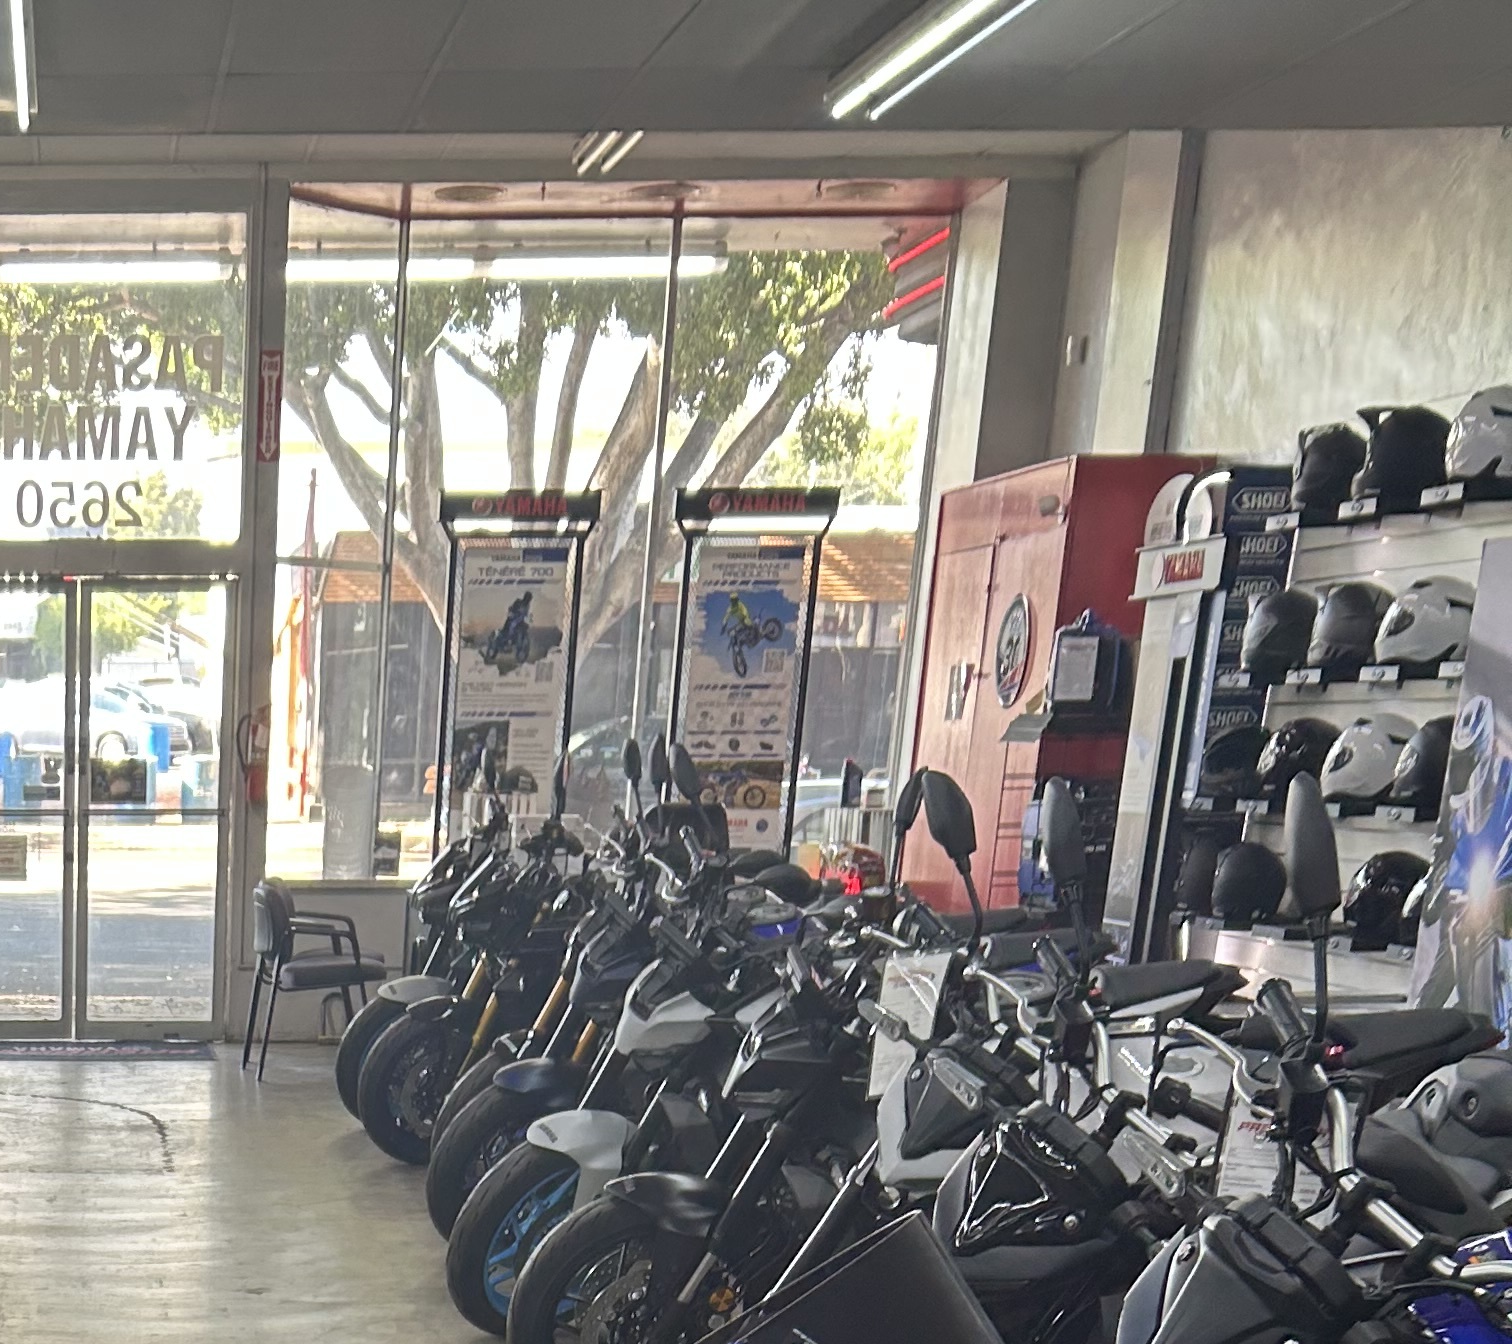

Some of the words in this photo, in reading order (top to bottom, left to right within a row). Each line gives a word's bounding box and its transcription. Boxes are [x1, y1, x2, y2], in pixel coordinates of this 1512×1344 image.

[495, 496, 568, 517] YAMAHA
[733, 492, 806, 513] YAMAHA
[1240, 490, 1288, 510] SHOEI
[477, 564, 527, 577] TÉNÉRÉ
[530, 566, 555, 577] 700
[1208, 709, 1250, 728] SHOEI
